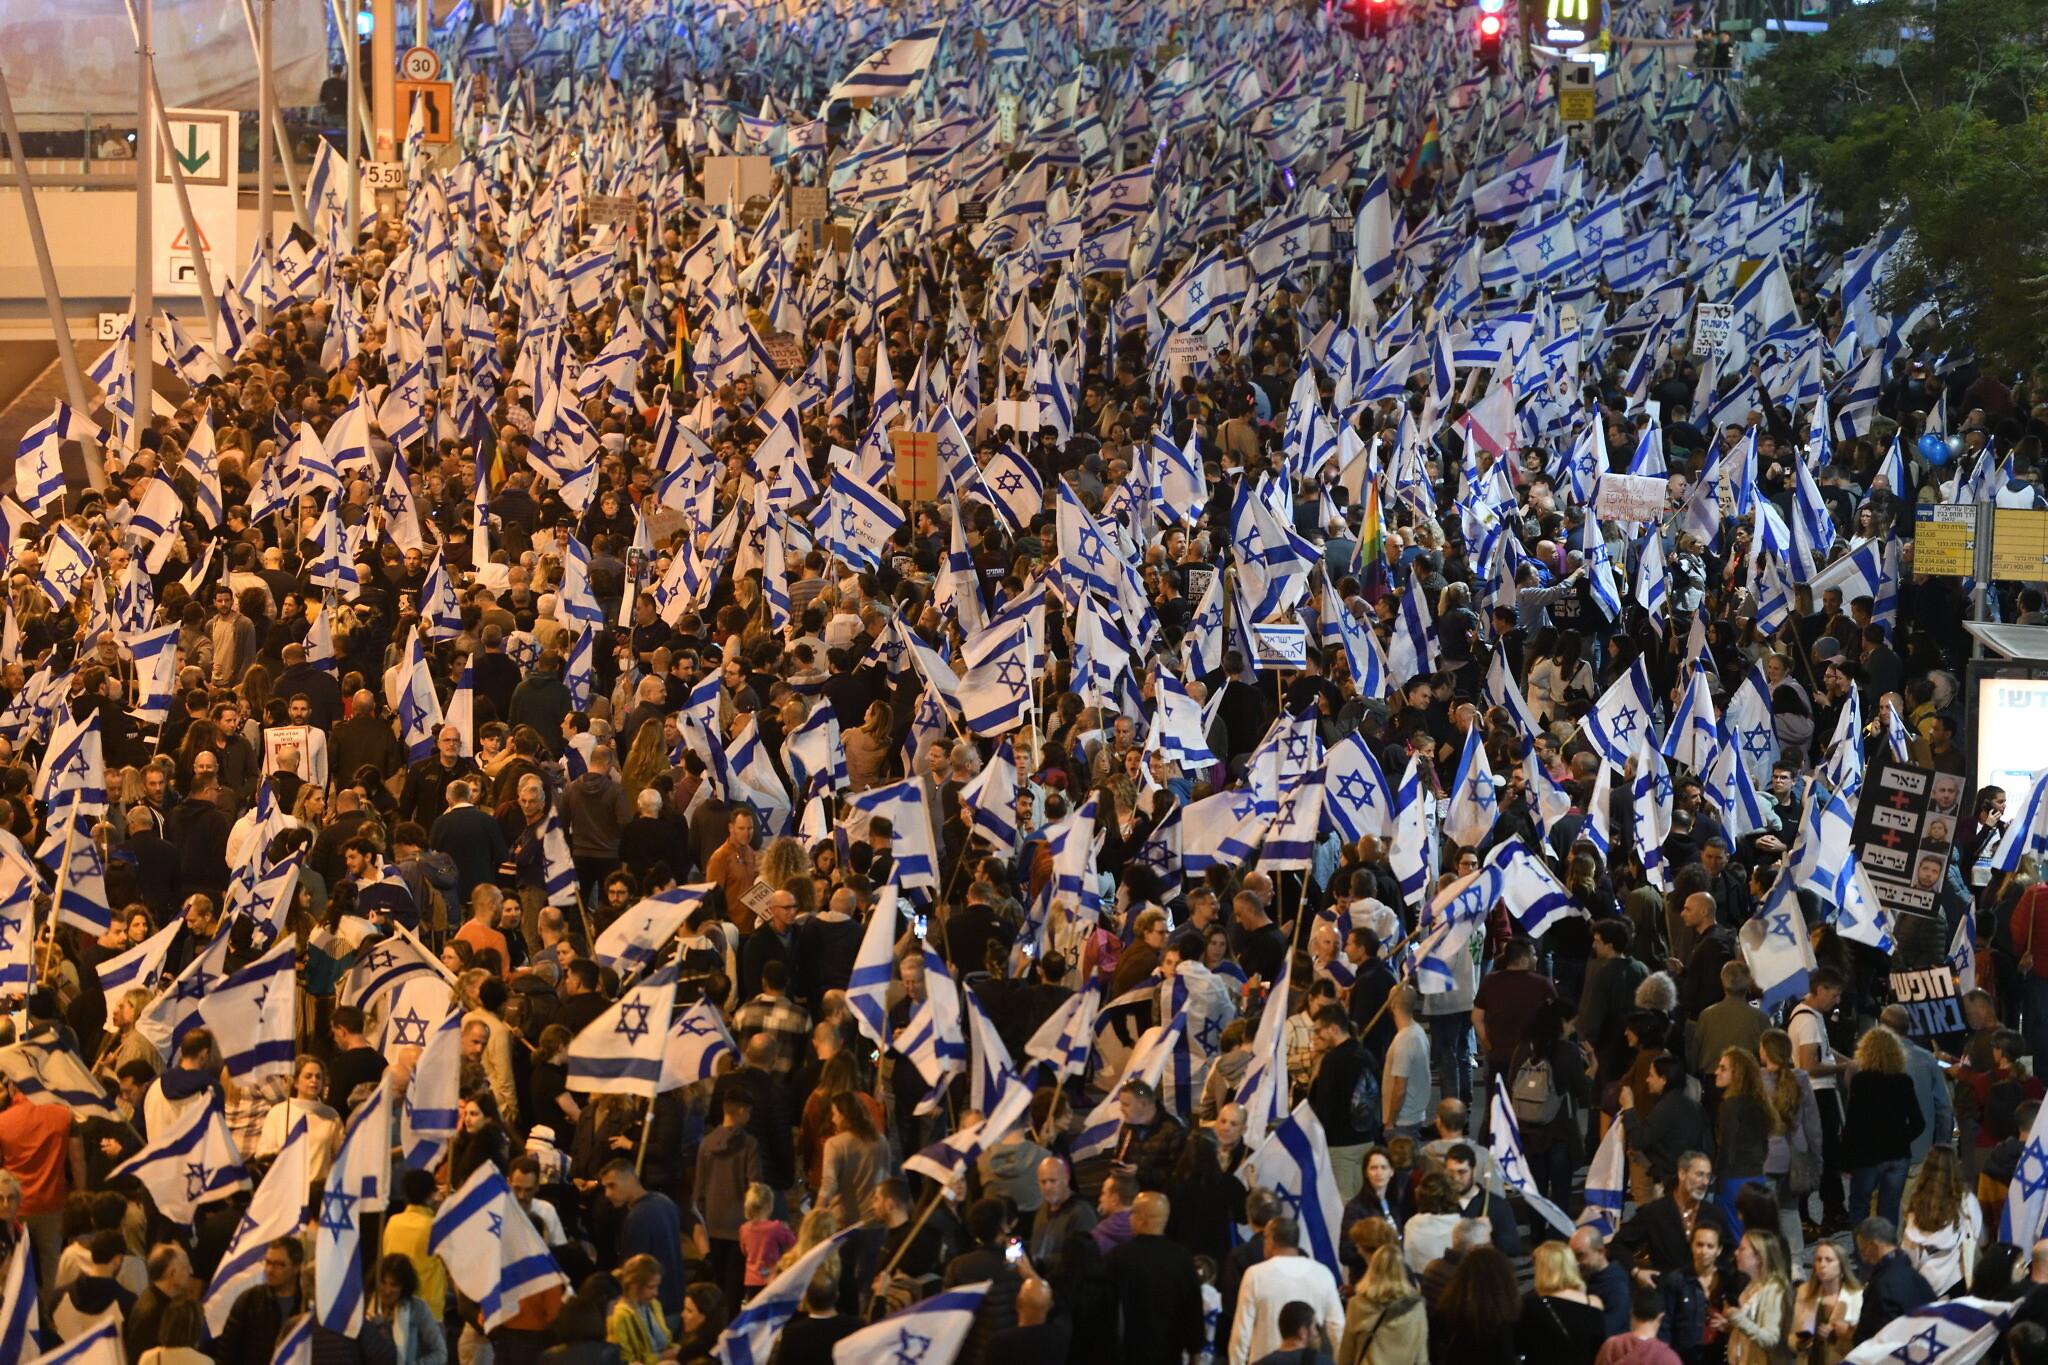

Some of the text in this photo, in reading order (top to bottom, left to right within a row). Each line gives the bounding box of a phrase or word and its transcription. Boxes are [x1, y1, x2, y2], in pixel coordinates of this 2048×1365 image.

[411, 59, 431, 72] 30
[368, 166, 401, 183] 5.50
[1714, 305, 1731, 319] לא
[1264, 635, 1291, 644] ישראל
[1890, 772, 1920, 789] צאר
[1879, 811, 1911, 828] צרה
[1867, 851, 1905, 870] צרצר
[1901, 892, 1932, 907] צרה
[1889, 966, 1956, 1003] חופשי
